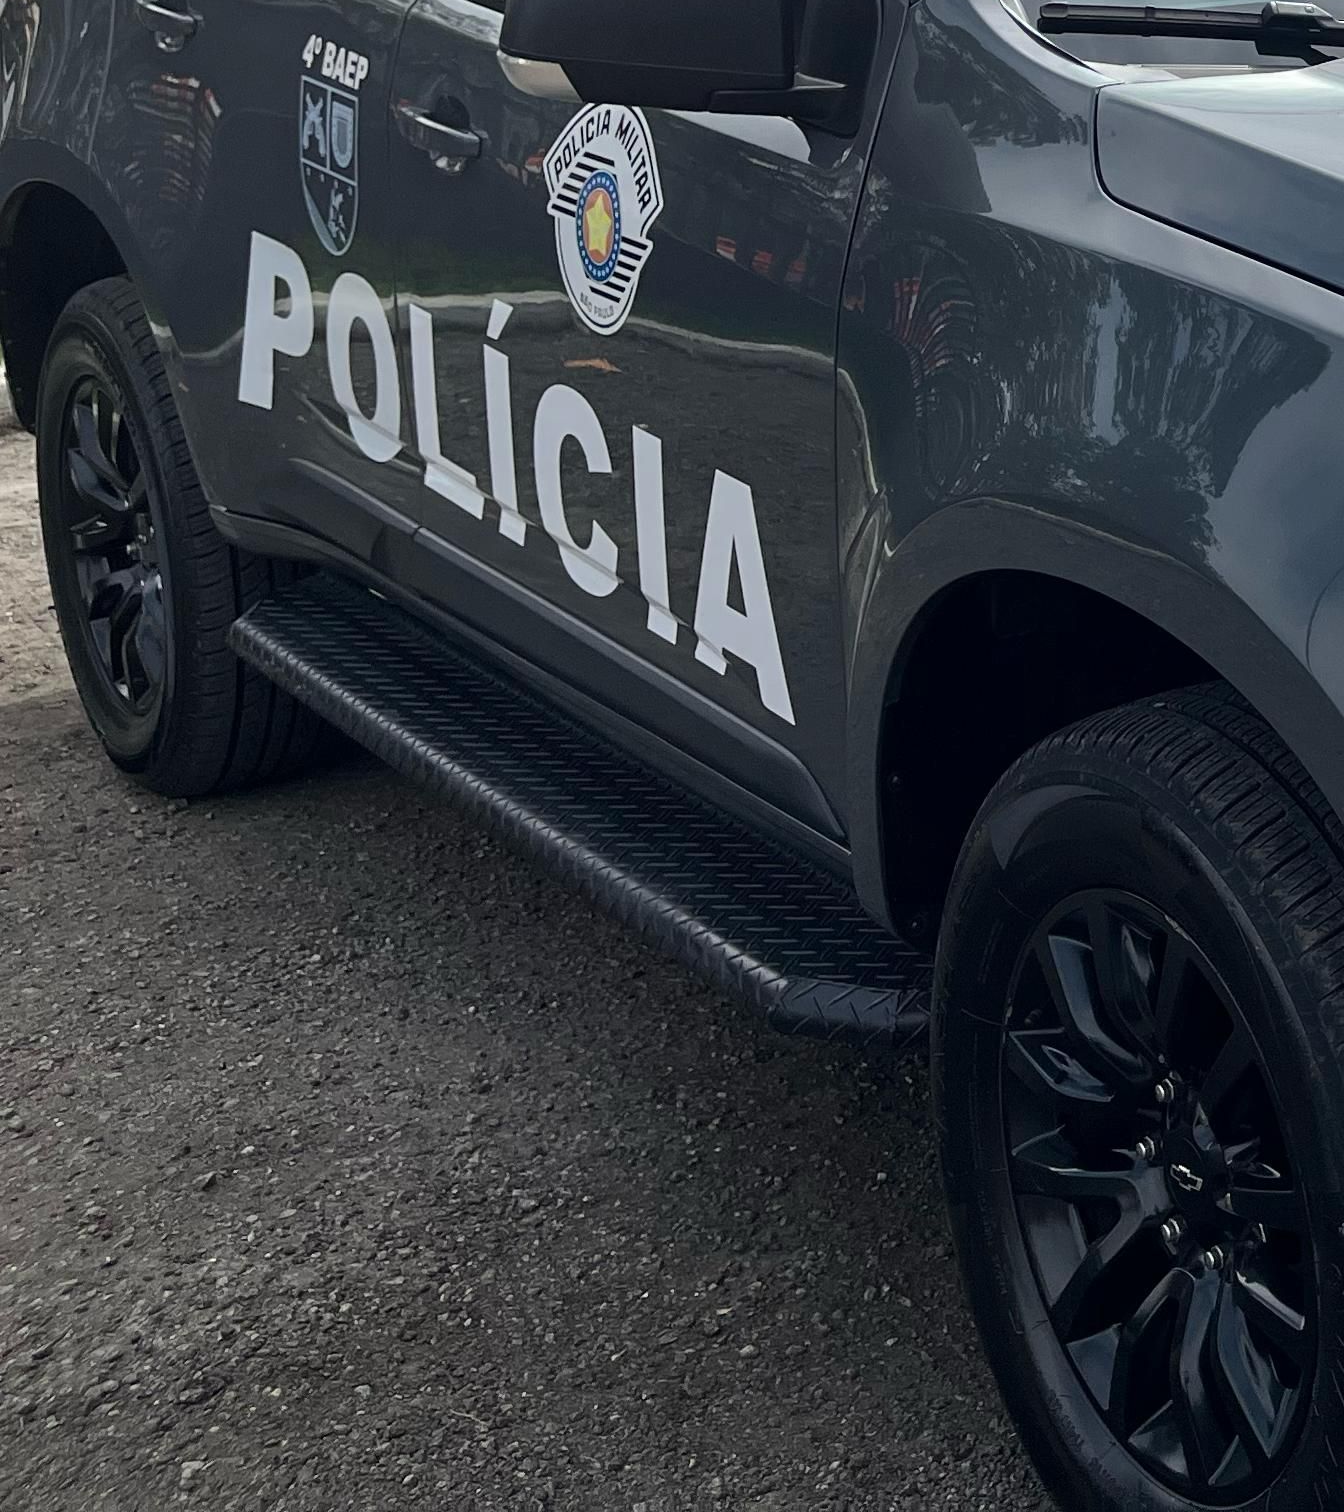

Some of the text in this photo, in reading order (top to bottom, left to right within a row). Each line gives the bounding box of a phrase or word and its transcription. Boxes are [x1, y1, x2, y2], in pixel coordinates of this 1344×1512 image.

[321, 41, 369, 90] BAEP
[615, 113, 652, 214] MILITAR
[238, 230, 796, 726] POLÍCIA
